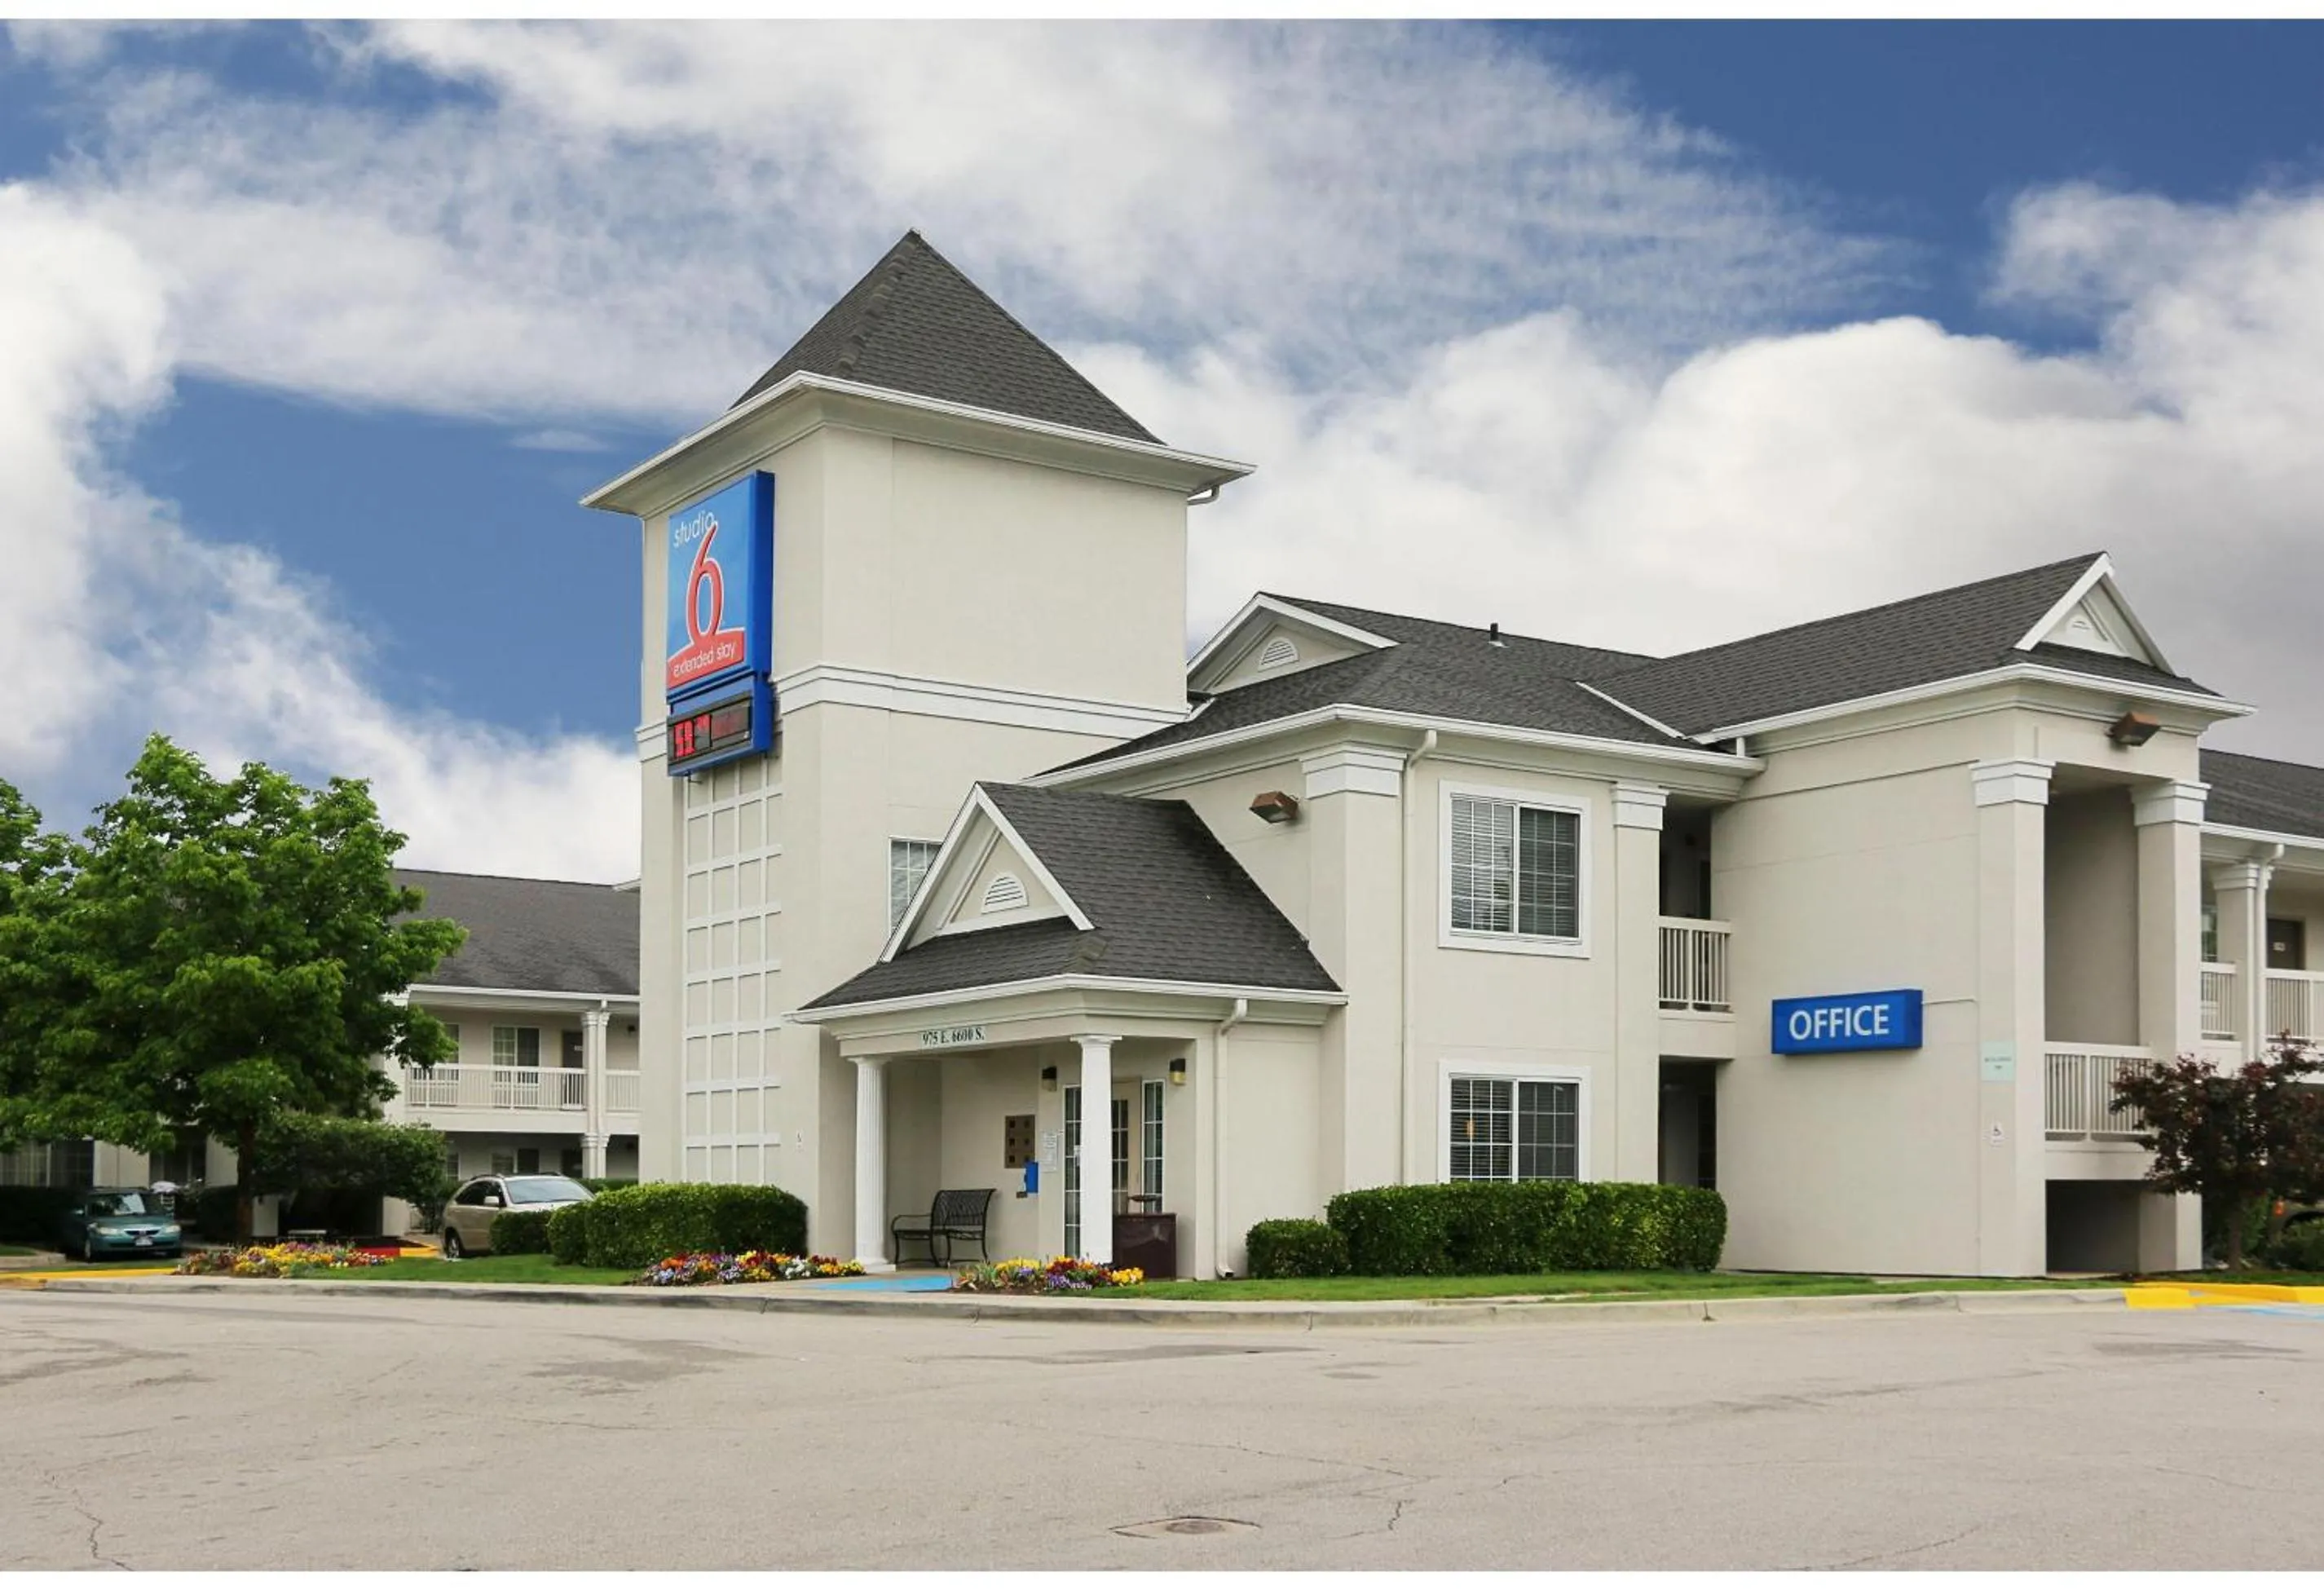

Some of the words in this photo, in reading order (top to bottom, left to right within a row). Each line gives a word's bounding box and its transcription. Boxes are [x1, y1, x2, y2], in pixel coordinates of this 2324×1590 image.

[673, 510, 715, 549] studio
[686, 520, 724, 643] 6
[673, 645, 714, 678] extended
[717, 640, 737, 660] stay
[923, 1030, 938, 1045] 975
[1789, 1004, 1890, 1040] OFFICE
